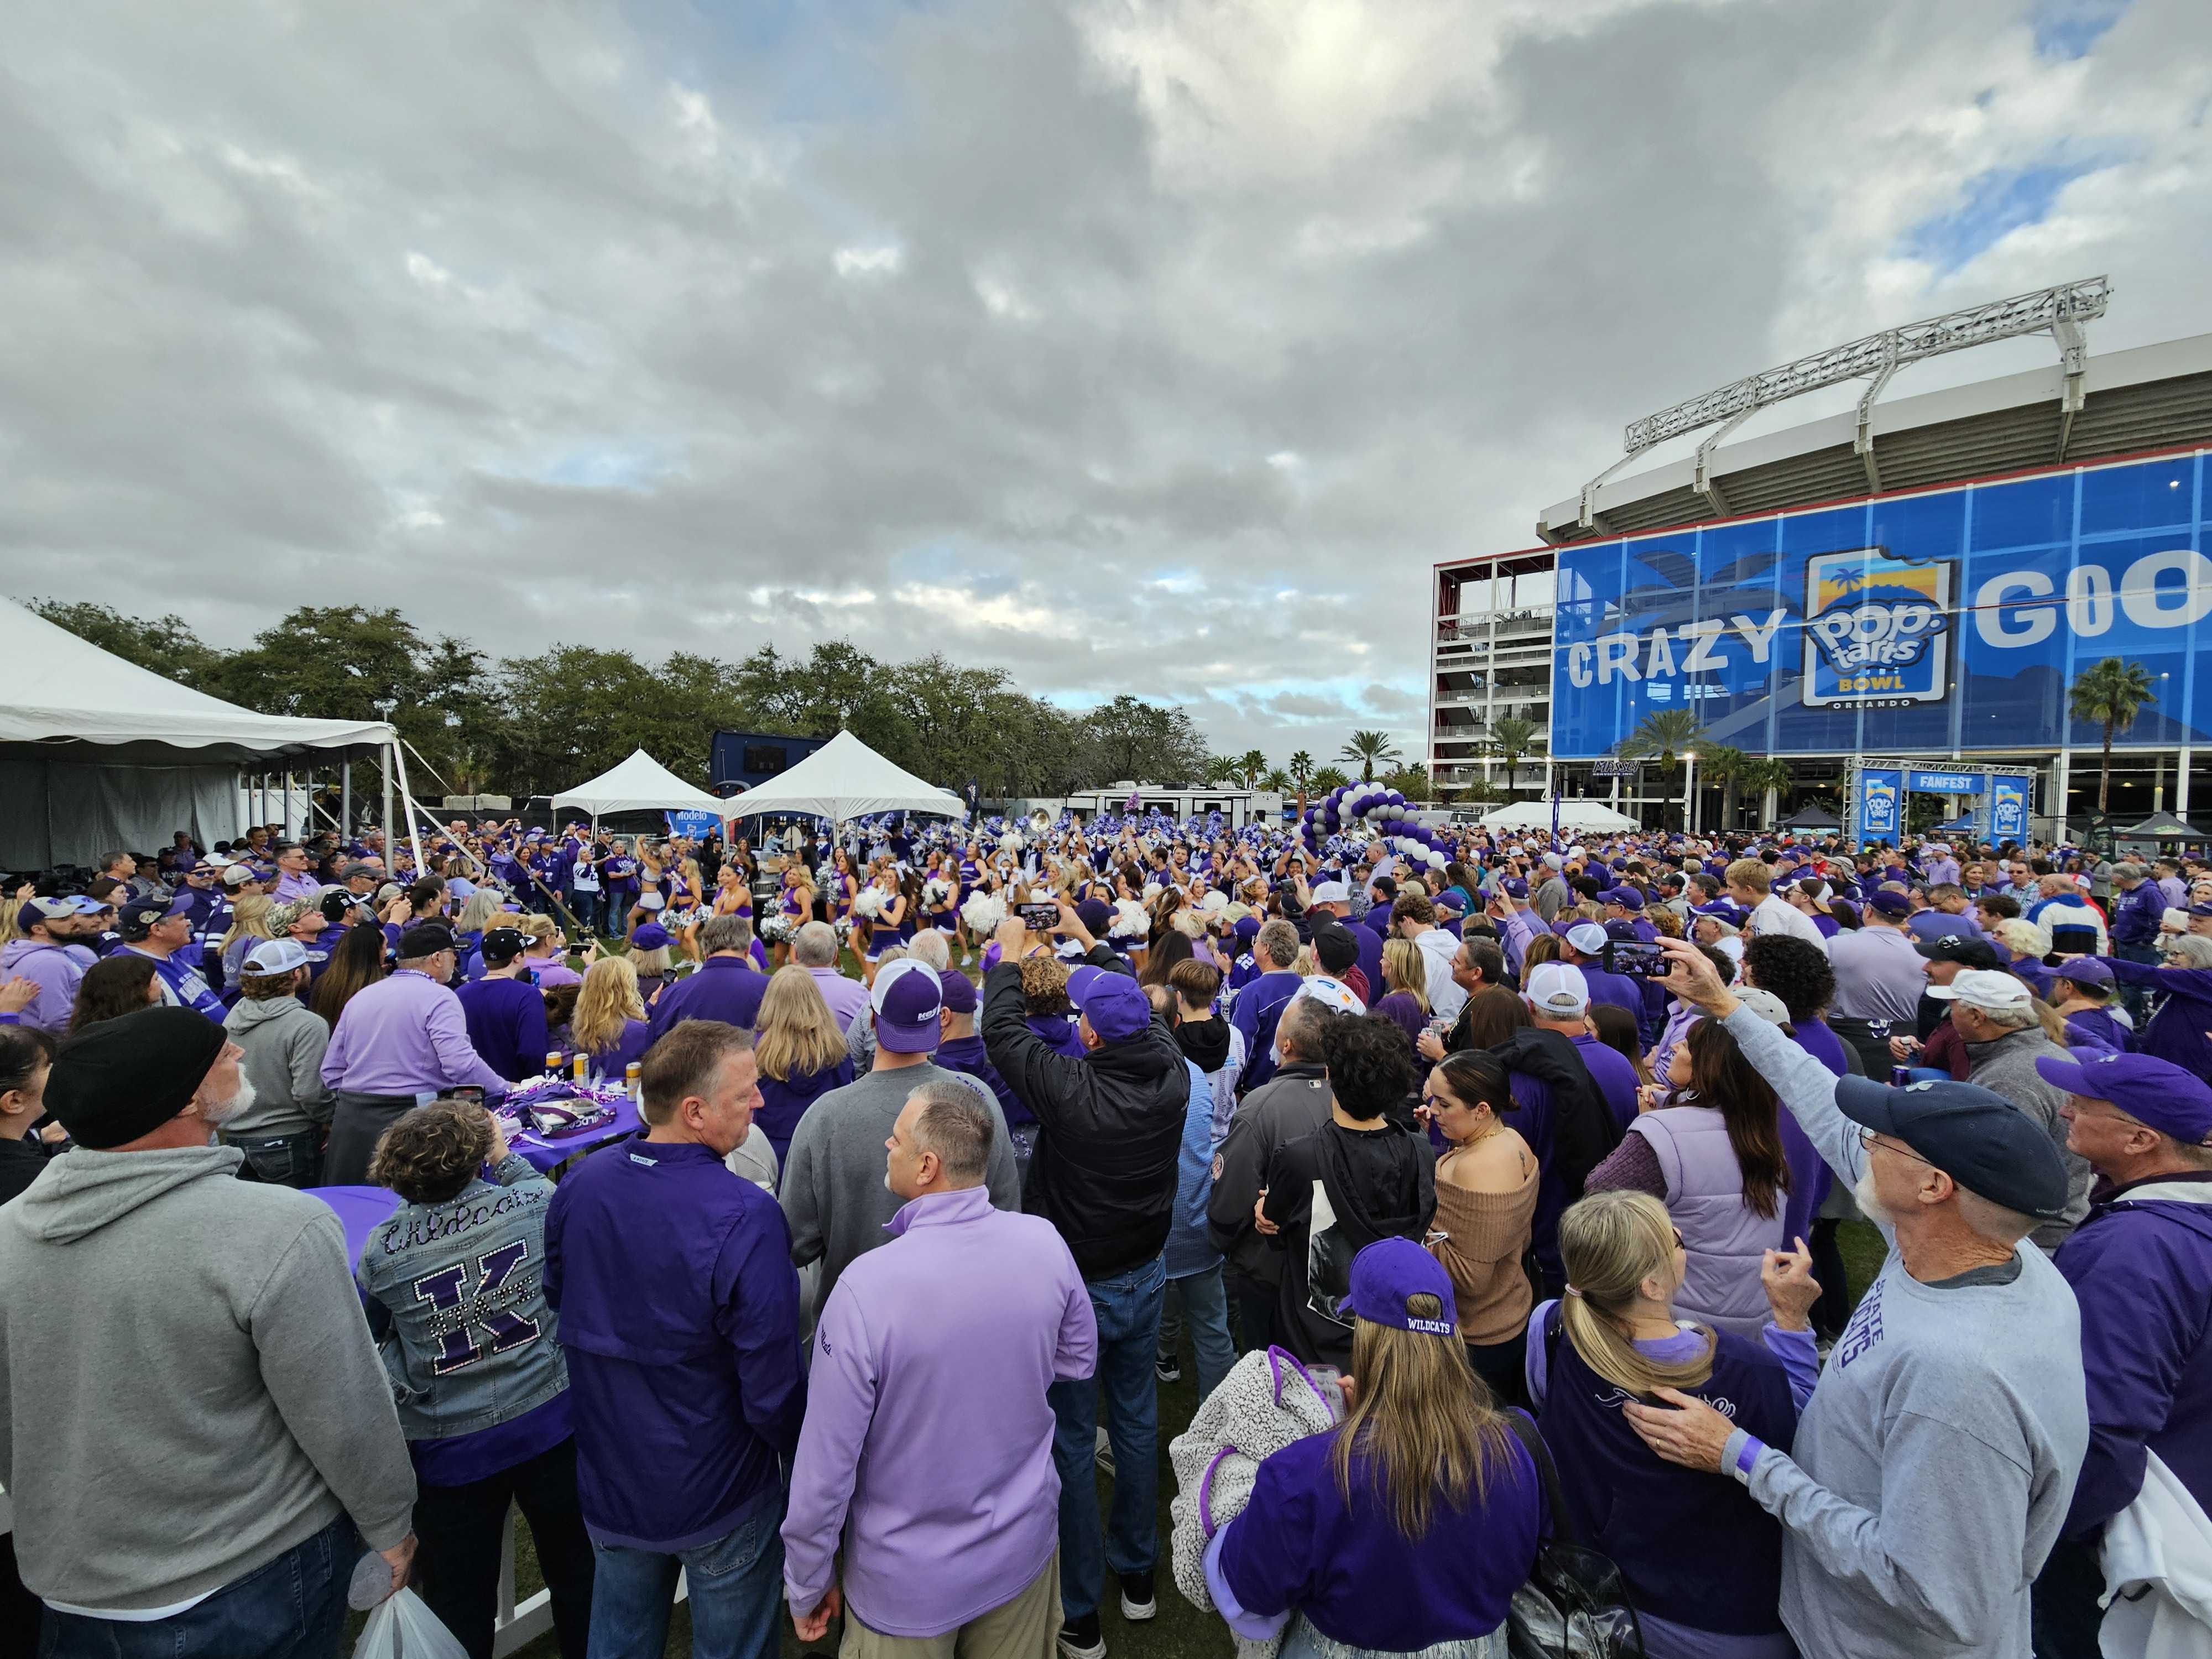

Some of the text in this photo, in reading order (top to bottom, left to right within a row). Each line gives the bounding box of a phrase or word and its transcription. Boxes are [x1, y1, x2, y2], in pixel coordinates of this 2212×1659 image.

[1975, 550, 2212, 648] GOO
[1568, 608, 1787, 688] CRAZY
[1838, 675, 1906, 692] BOWL
[1833, 699, 1910, 709] ORLANDO
[1593, 760, 1640, 773] MASSEY
[1920, 776, 1973, 789] FANFEST
[676, 810, 707, 821] Modelo
[380, 1187, 544, 1255] Wildcats
[425, 1276, 535, 1338] STATE
[1870, 1279, 1886, 1347] STATE
[1407, 1318, 1450, 1334] WILDCATS
